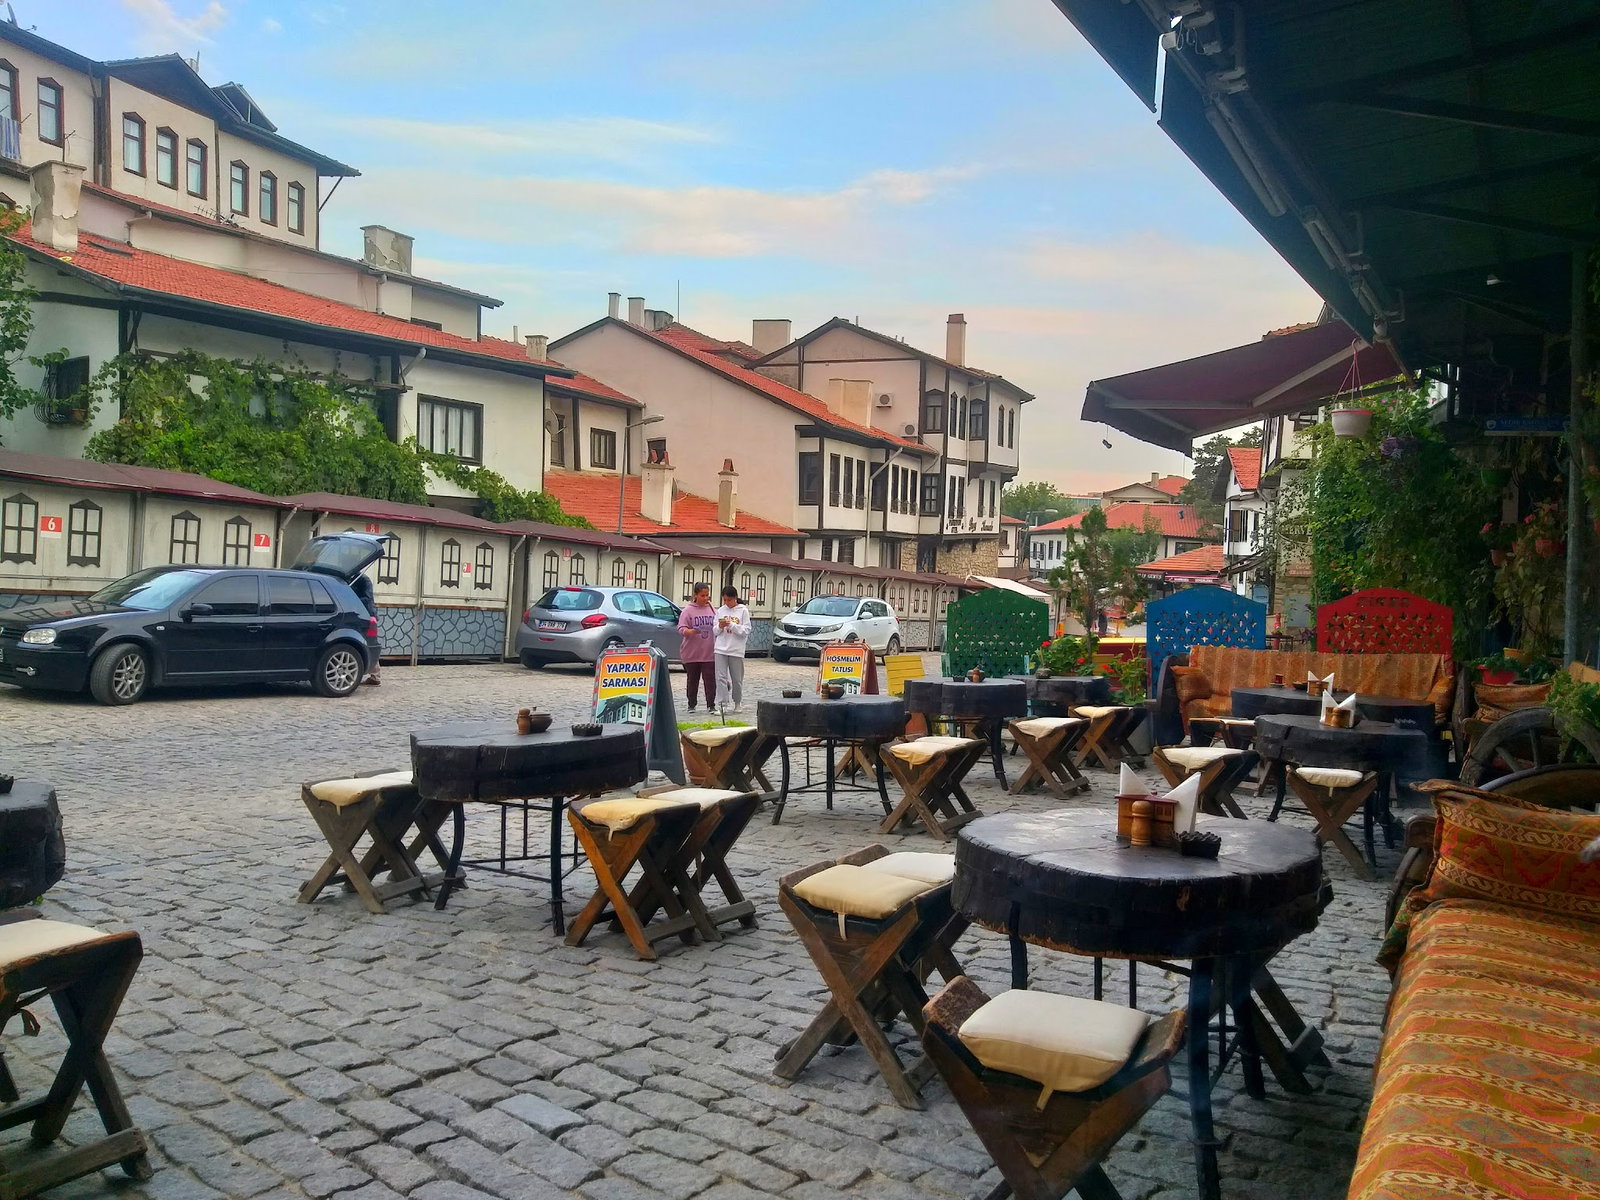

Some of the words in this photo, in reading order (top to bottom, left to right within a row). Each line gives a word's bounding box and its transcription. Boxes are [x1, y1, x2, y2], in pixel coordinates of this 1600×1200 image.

[48, 517, 56, 531] 6
[370, 524, 376, 533] 8
[260, 534, 266, 546] 7
[606, 663, 646, 673] YAPRAK
[602, 677, 647, 688] SARMASI
